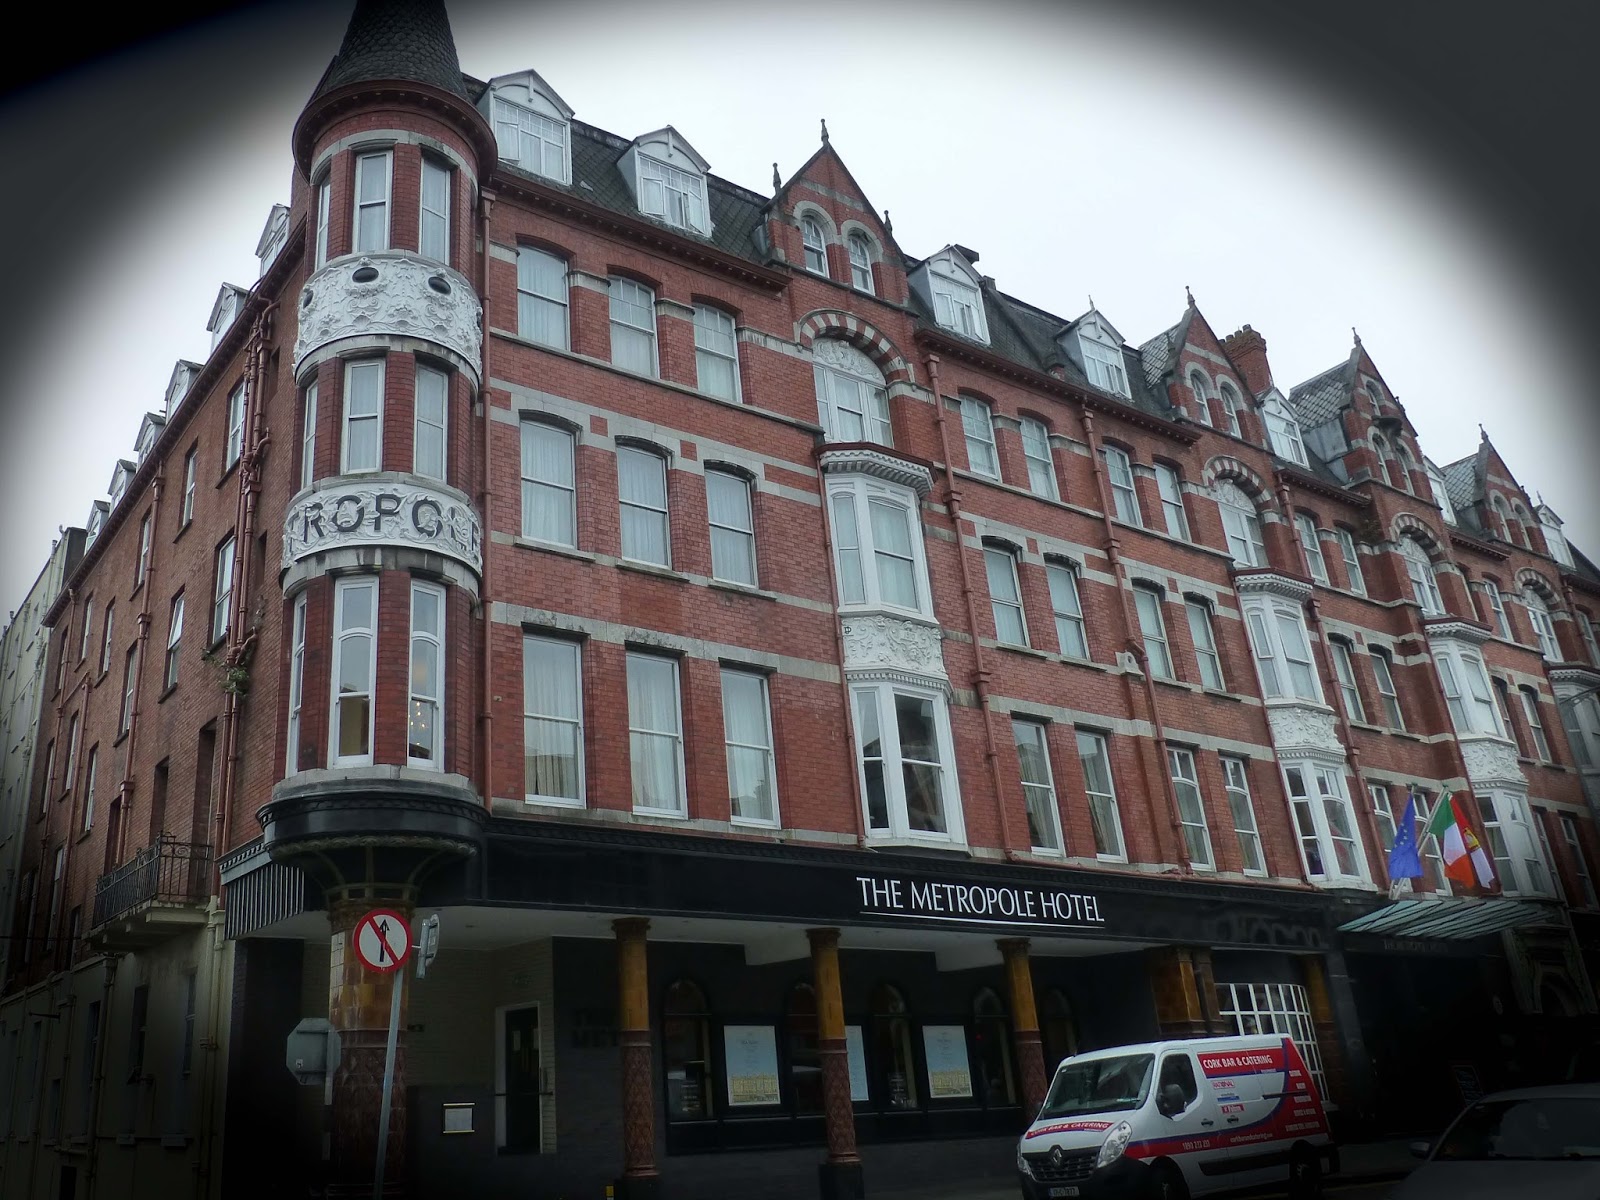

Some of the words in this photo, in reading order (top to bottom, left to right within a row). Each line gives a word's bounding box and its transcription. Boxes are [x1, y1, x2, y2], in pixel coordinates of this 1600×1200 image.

[856, 876, 904, 909] THE
[911, 881, 1037, 917] METROPOLE
[1040, 891, 1105, 922] HOTEL
[1203, 1058, 1222, 1069] CORK
[1223, 1057, 1237, 1068] BAR
[1237, 1057, 1244, 1066] &
[1242, 1055, 1273, 1066] CATERING
